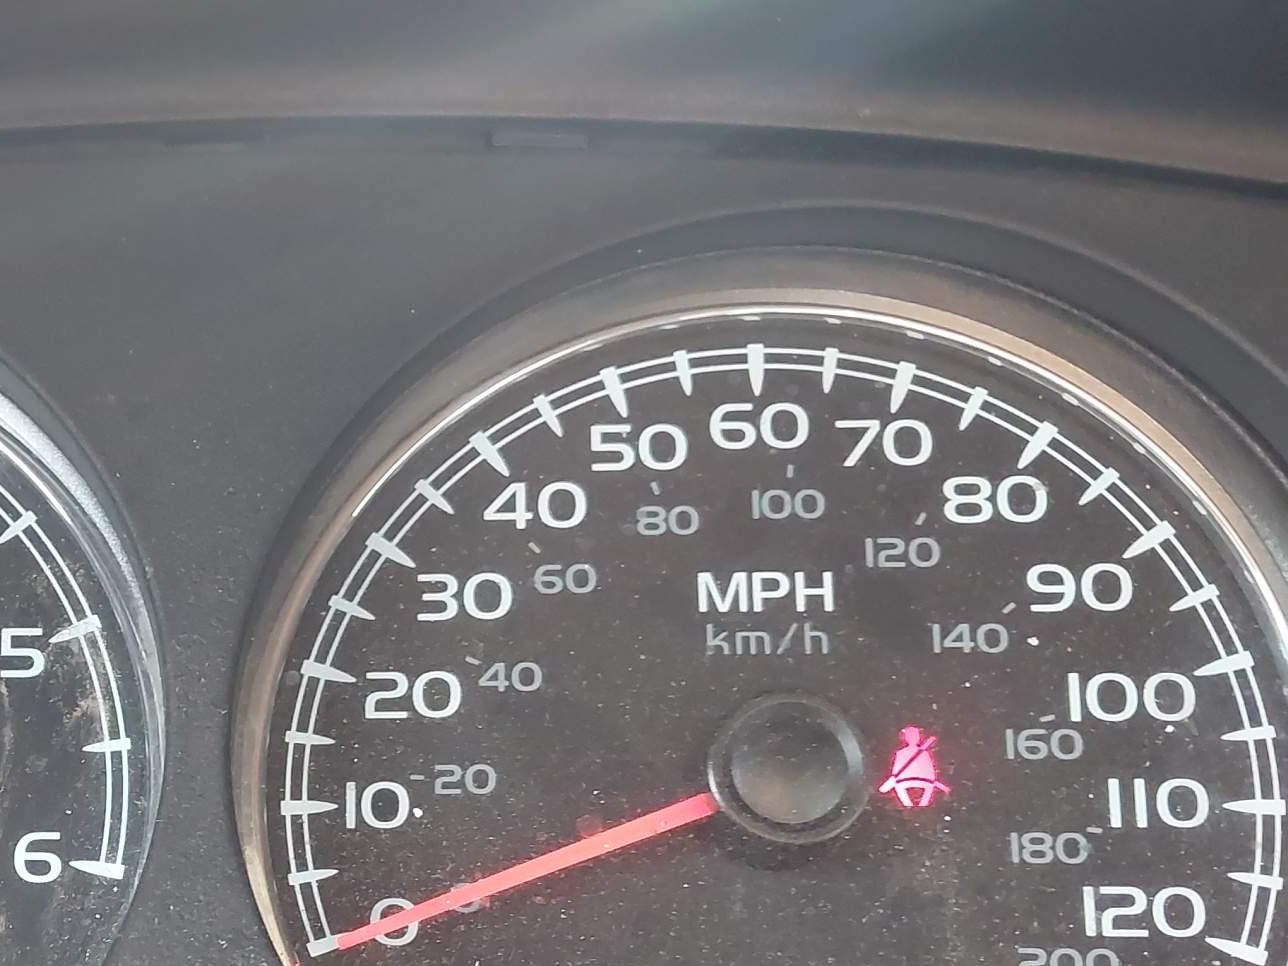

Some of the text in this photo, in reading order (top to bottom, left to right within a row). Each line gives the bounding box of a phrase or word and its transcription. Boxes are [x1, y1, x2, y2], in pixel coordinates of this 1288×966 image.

[591, 424, 688, 471] 50
[709, 403, 810, 450] 60
[835, 419, 933, 467] 70
[483, 482, 587, 529] 40
[636, 505, 699, 535] 80
[751, 489, 825, 520] 100
[942, 476, 1048, 523] 80
[864, 537, 941, 568] 120
[417, 572, 513, 621] 30
[533, 564, 597, 594] 60
[697, 571, 834, 612] MPH
[1026, 563, 1133, 612] 90
[0, 627, 45, 678] 5
[706, 624, 829, 655] km/h
[931, 623, 1009, 653] 140
[364, 670, 462, 719] 20
[478, 662, 542, 692] 40
[1067, 672, 1196, 722] 100
[1005, 728, 1084, 760] 160
[434, 764, 497, 794] 20
[346, 781, 410, 829] 10
[1107, 778, 1210, 828] 110
[13, 832, 61, 883] 6
[1010, 832, 1089, 864] 180
[369, 898, 419, 946] 0
[1082, 886, 1206, 937] 120
